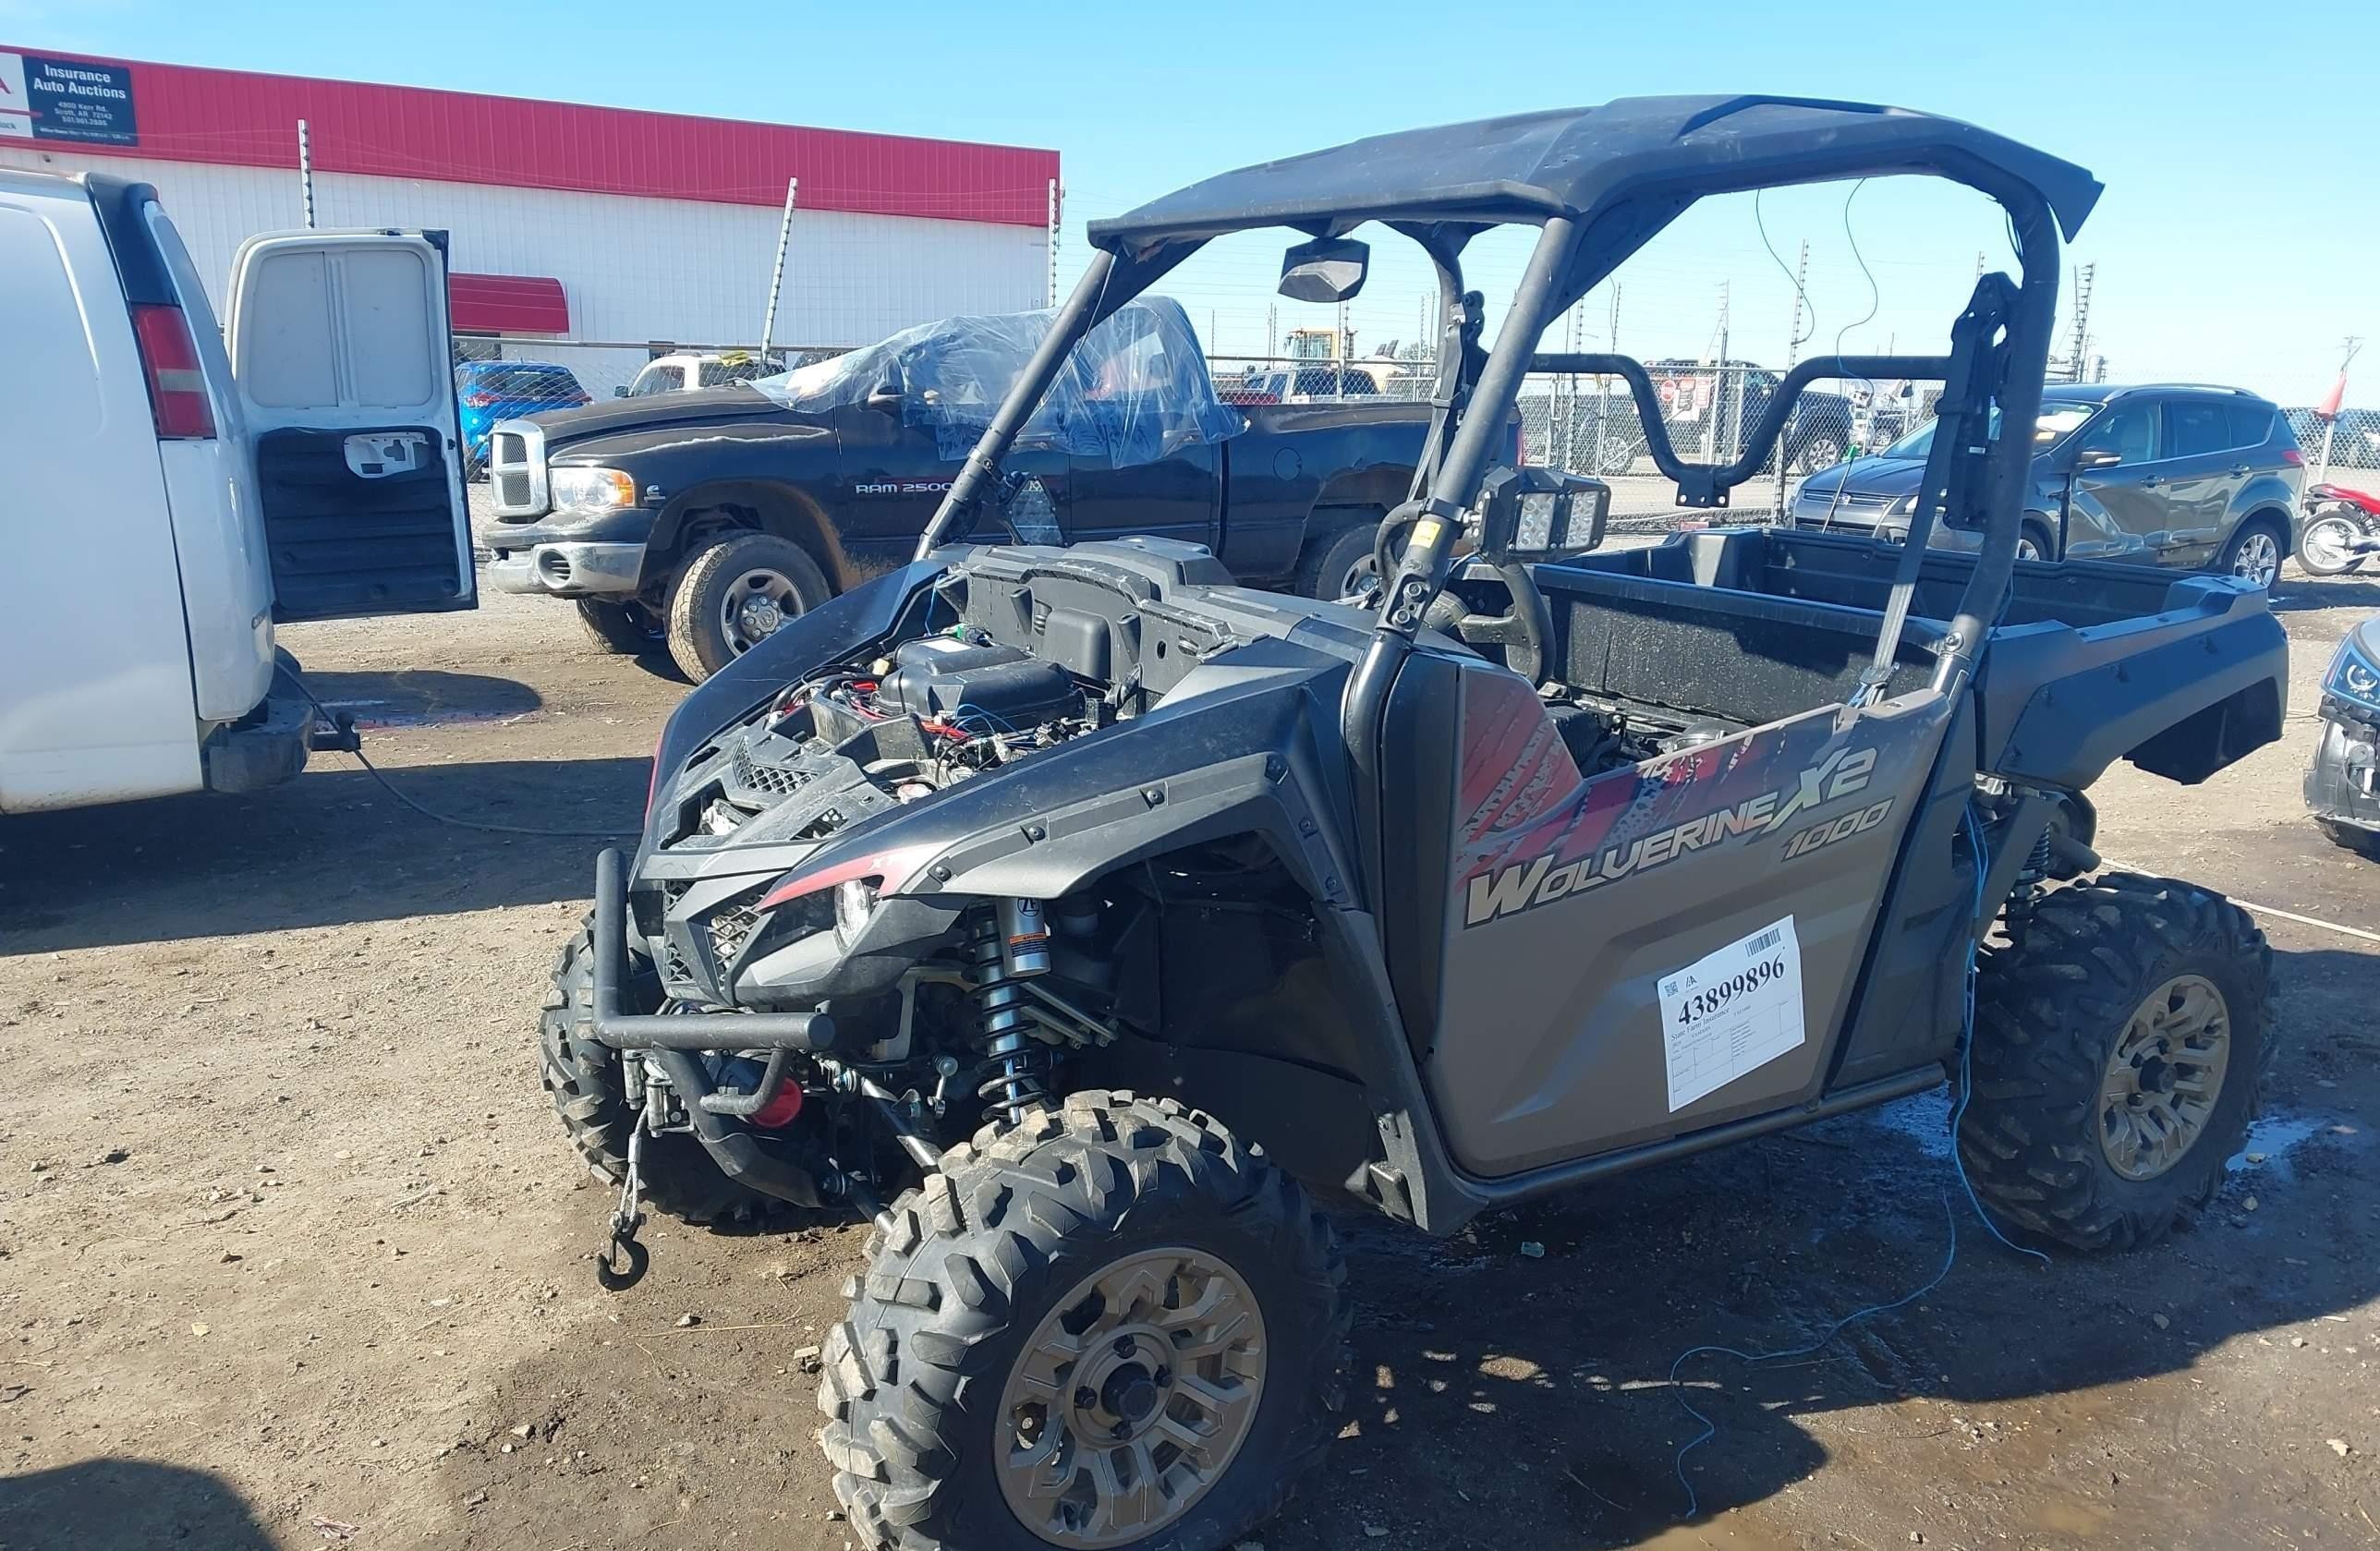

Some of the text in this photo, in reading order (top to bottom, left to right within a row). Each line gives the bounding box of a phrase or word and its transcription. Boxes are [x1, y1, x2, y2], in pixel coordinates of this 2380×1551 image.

[33, 78, 127, 99] Auto Auctions
[43, 64, 112, 83] Insurance
[856, 482, 955, 494] RAM 2500
[1758, 746, 1878, 836] X2
[1782, 797, 1895, 861] 1000
[1679, 952, 1785, 1025] 43899896
[1670, 1028, 1686, 1042] State
[1686, 1018, 1704, 1035] Farm
[1703, 1007, 1730, 1025] Insurance
